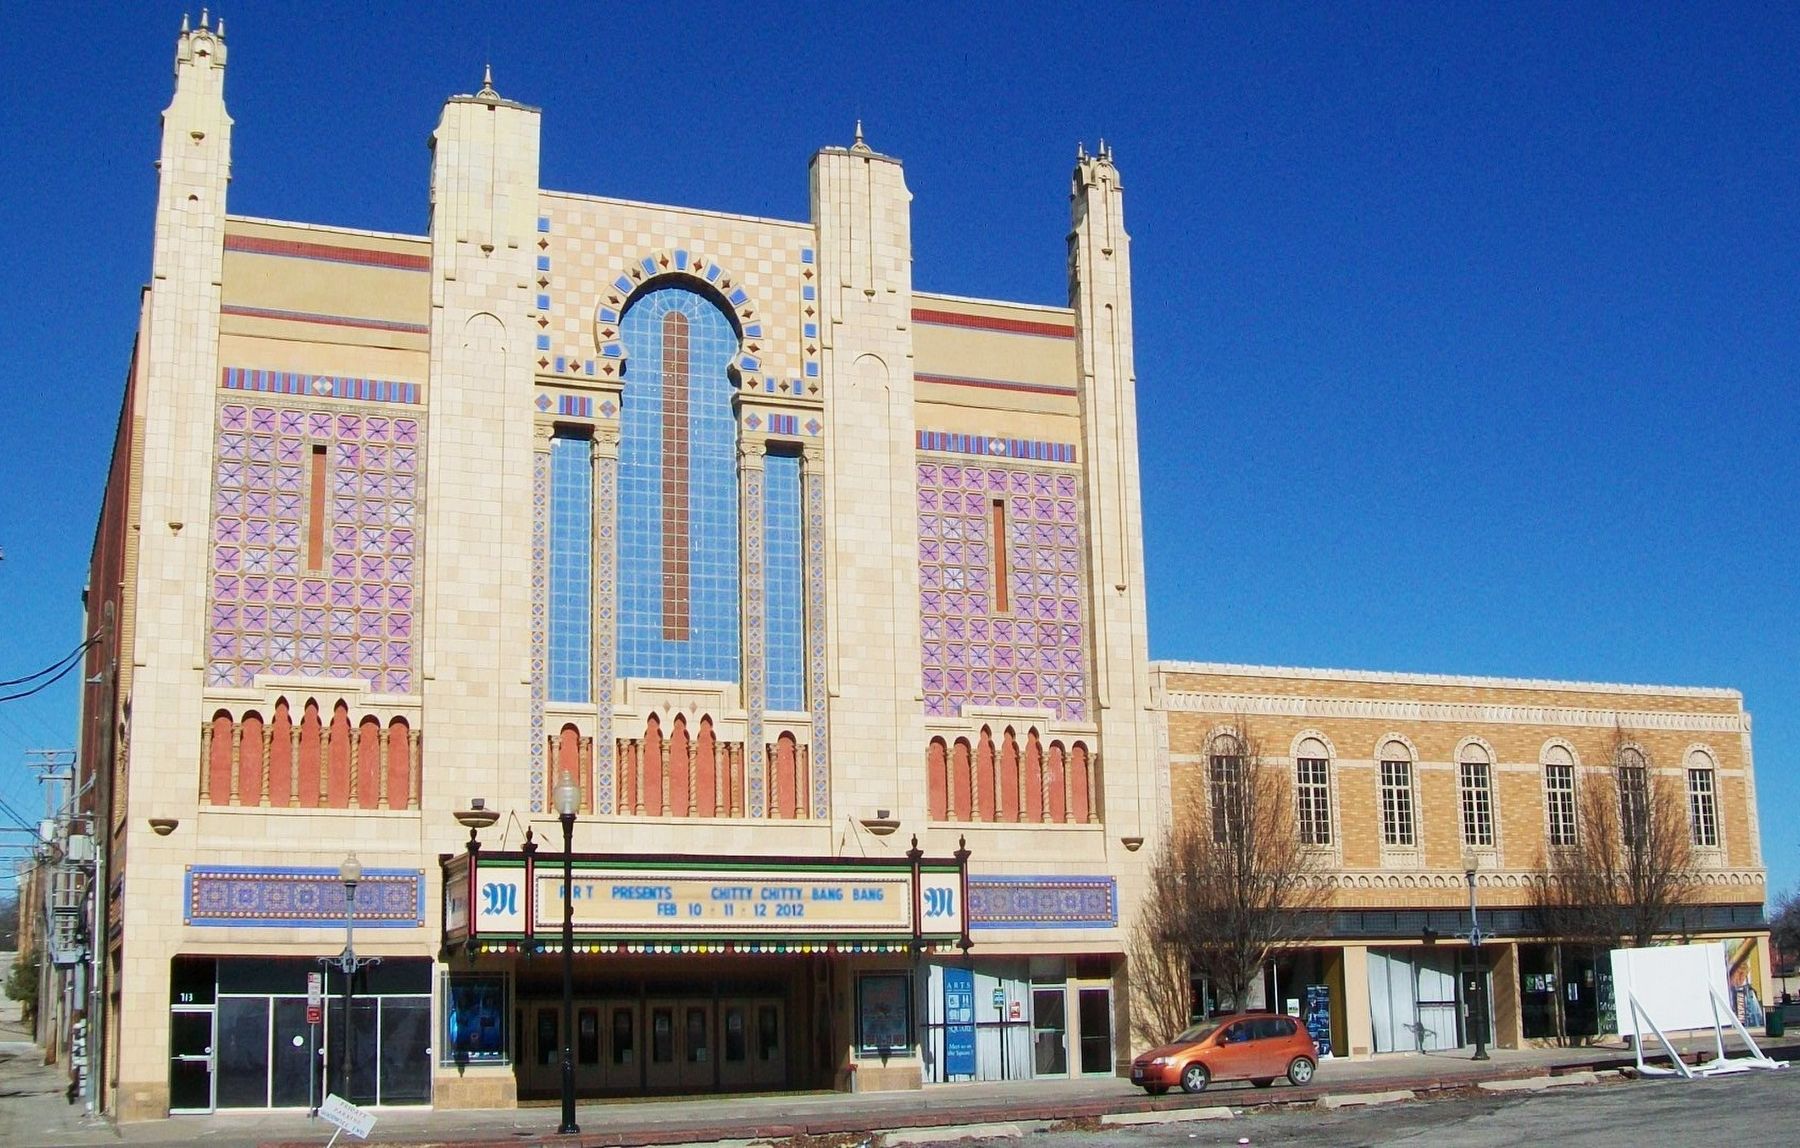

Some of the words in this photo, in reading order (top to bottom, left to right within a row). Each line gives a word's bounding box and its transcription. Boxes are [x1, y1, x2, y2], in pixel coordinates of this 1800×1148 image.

[481, 882, 518, 916] M
[612, 887, 672, 899] PRESENTS
[711, 887, 752, 899] CHITTY
[761, 887, 802, 900] CHITTY
[812, 888, 843, 900] BANG
[853, 888, 884, 901] BANG
[923, 887, 955, 917] M
[657, 904, 677, 916] FEB
[689, 903, 702, 916] 10
[724, 904, 734, 916] 11
[754, 904, 767, 917] 12
[776, 904, 804, 917] 2012
